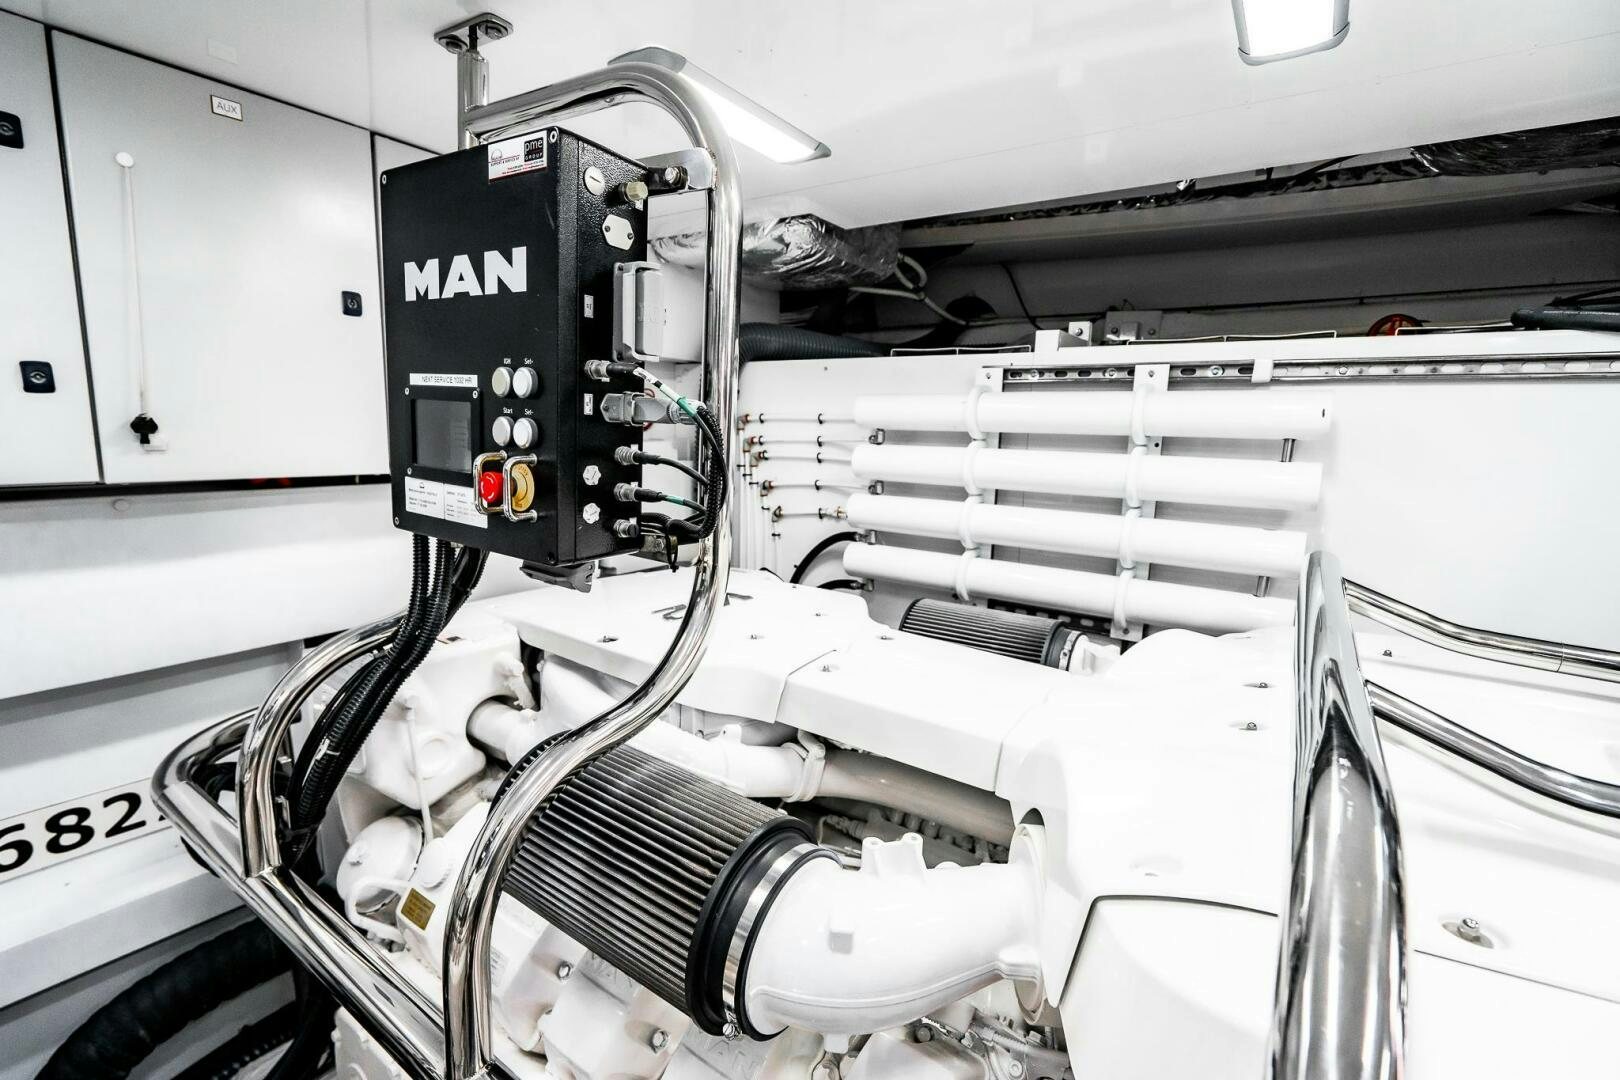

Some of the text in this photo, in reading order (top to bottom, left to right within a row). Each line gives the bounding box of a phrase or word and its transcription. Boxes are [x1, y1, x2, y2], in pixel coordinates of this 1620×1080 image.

[216, 102, 238, 114] AUX
[524, 139, 543, 154] pme
[404, 246, 527, 302] MAN
[421, 375, 433, 383] NEXT
[434, 375, 453, 384] SERVICE
[0, 791, 166, 873] 682
